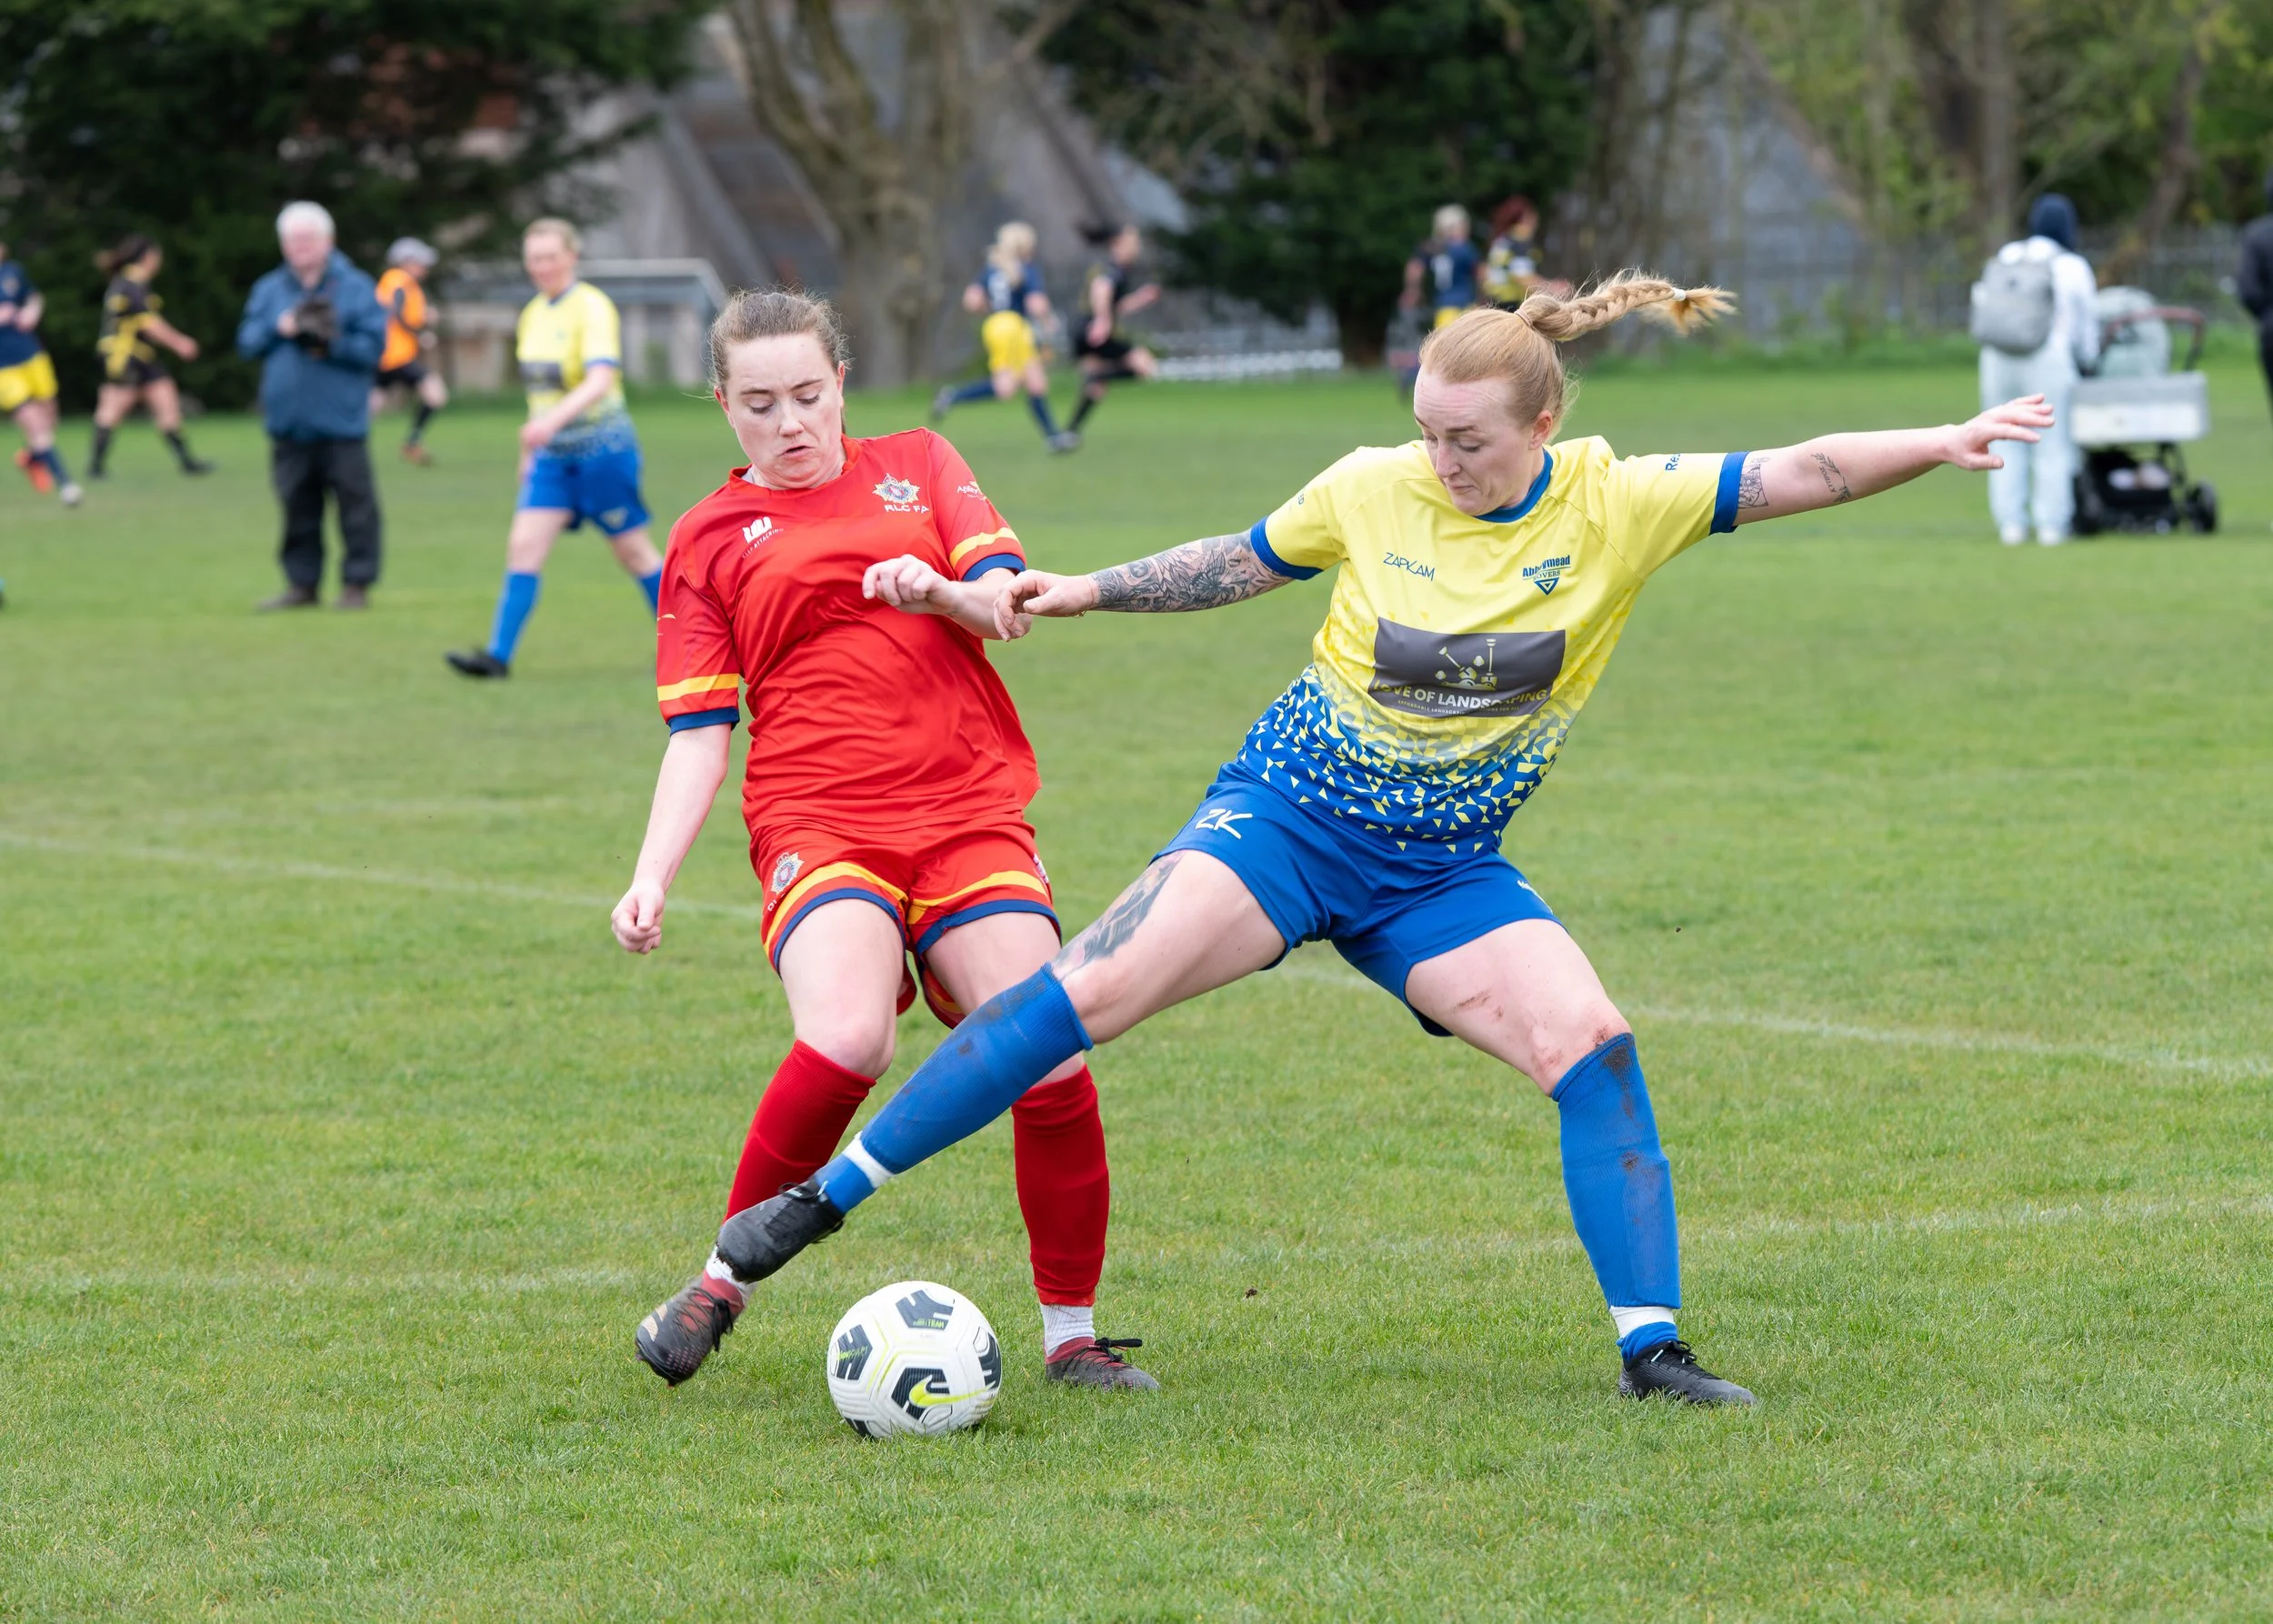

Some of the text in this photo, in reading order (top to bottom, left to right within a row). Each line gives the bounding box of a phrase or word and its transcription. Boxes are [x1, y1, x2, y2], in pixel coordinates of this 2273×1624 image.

[884, 504, 929, 514] RLC FA
[1383, 552, 1435, 582] ZAPKAM
[1414, 688, 1436, 703] OF
[1437, 688, 1547, 709] LANDSCPING
[1195, 808, 1253, 839] ZK
